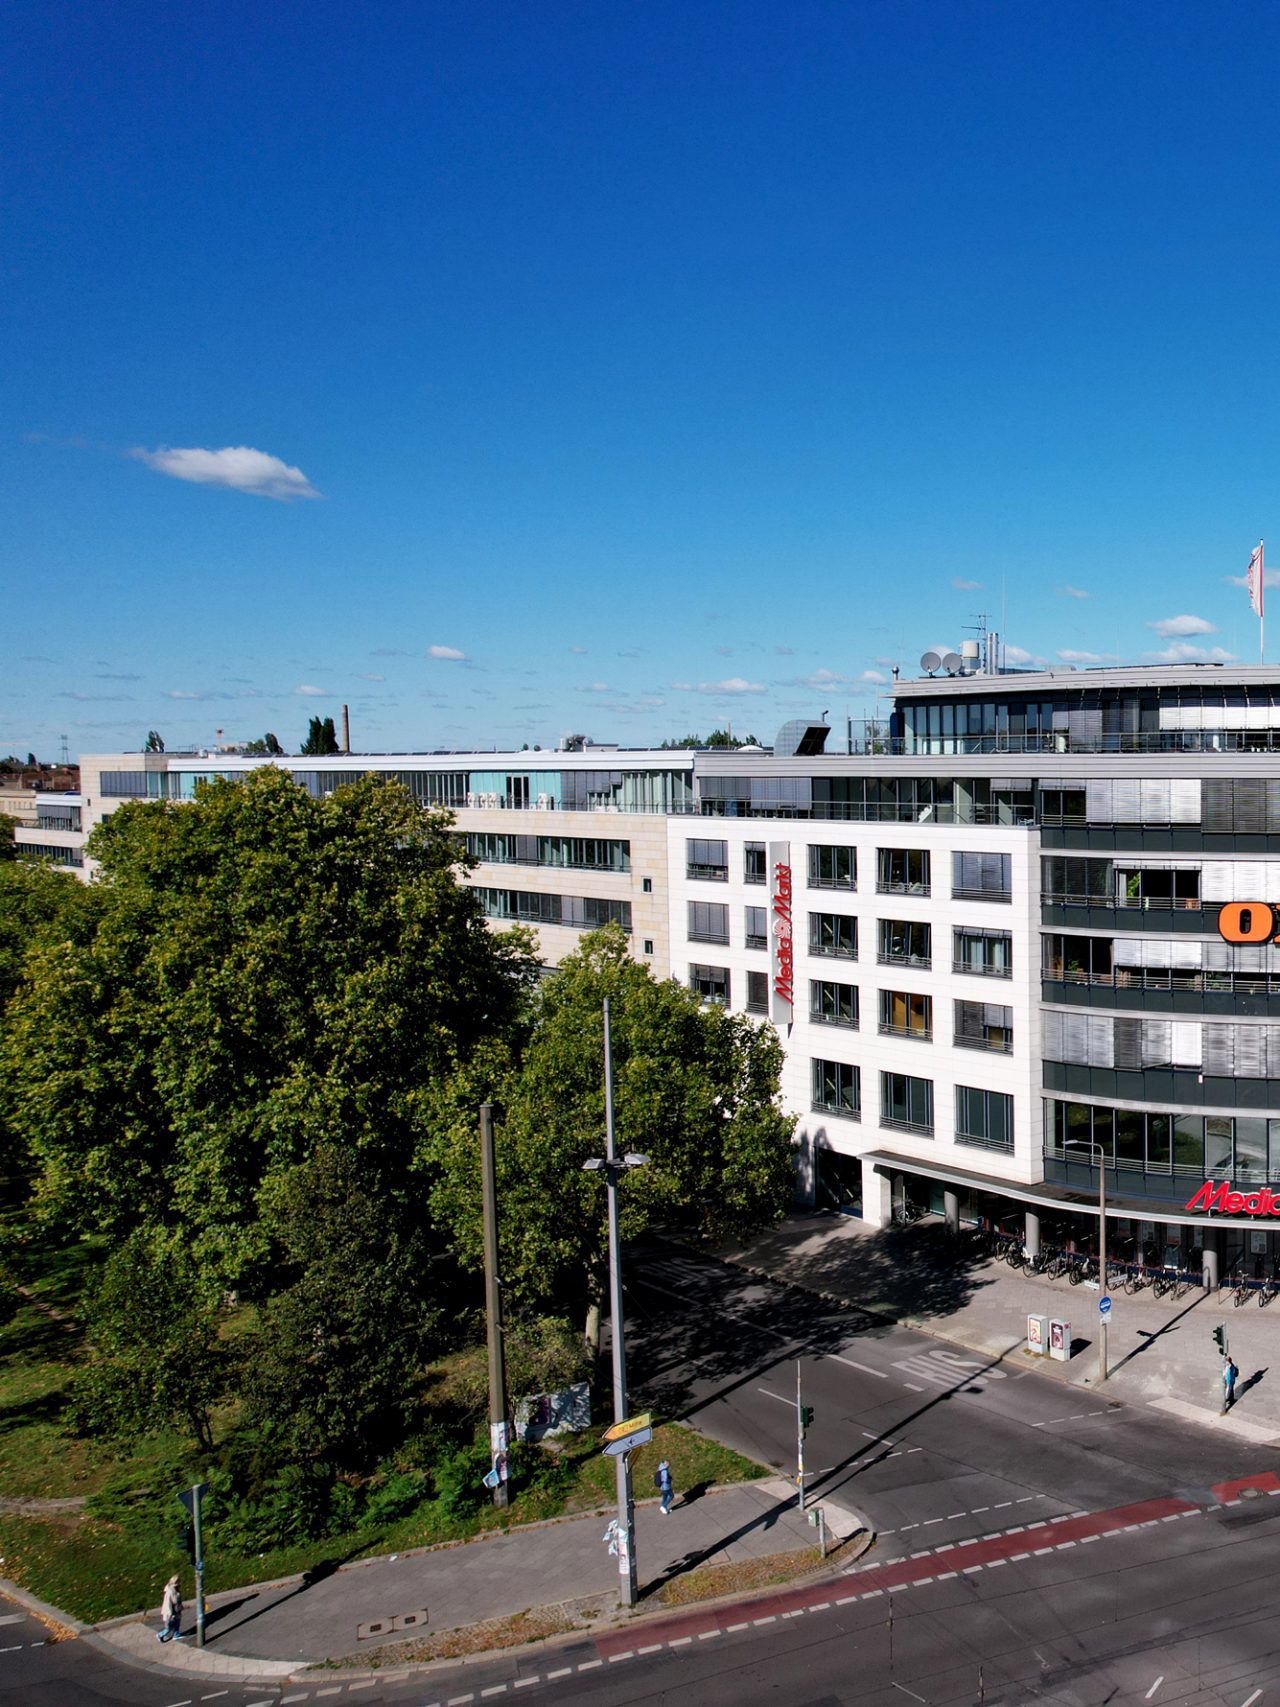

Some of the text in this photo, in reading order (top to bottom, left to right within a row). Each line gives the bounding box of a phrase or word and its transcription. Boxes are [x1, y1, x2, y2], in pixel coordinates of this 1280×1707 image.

[772, 862, 794, 1005] Media Markt
[890, 1350, 1008, 1392] BUS
